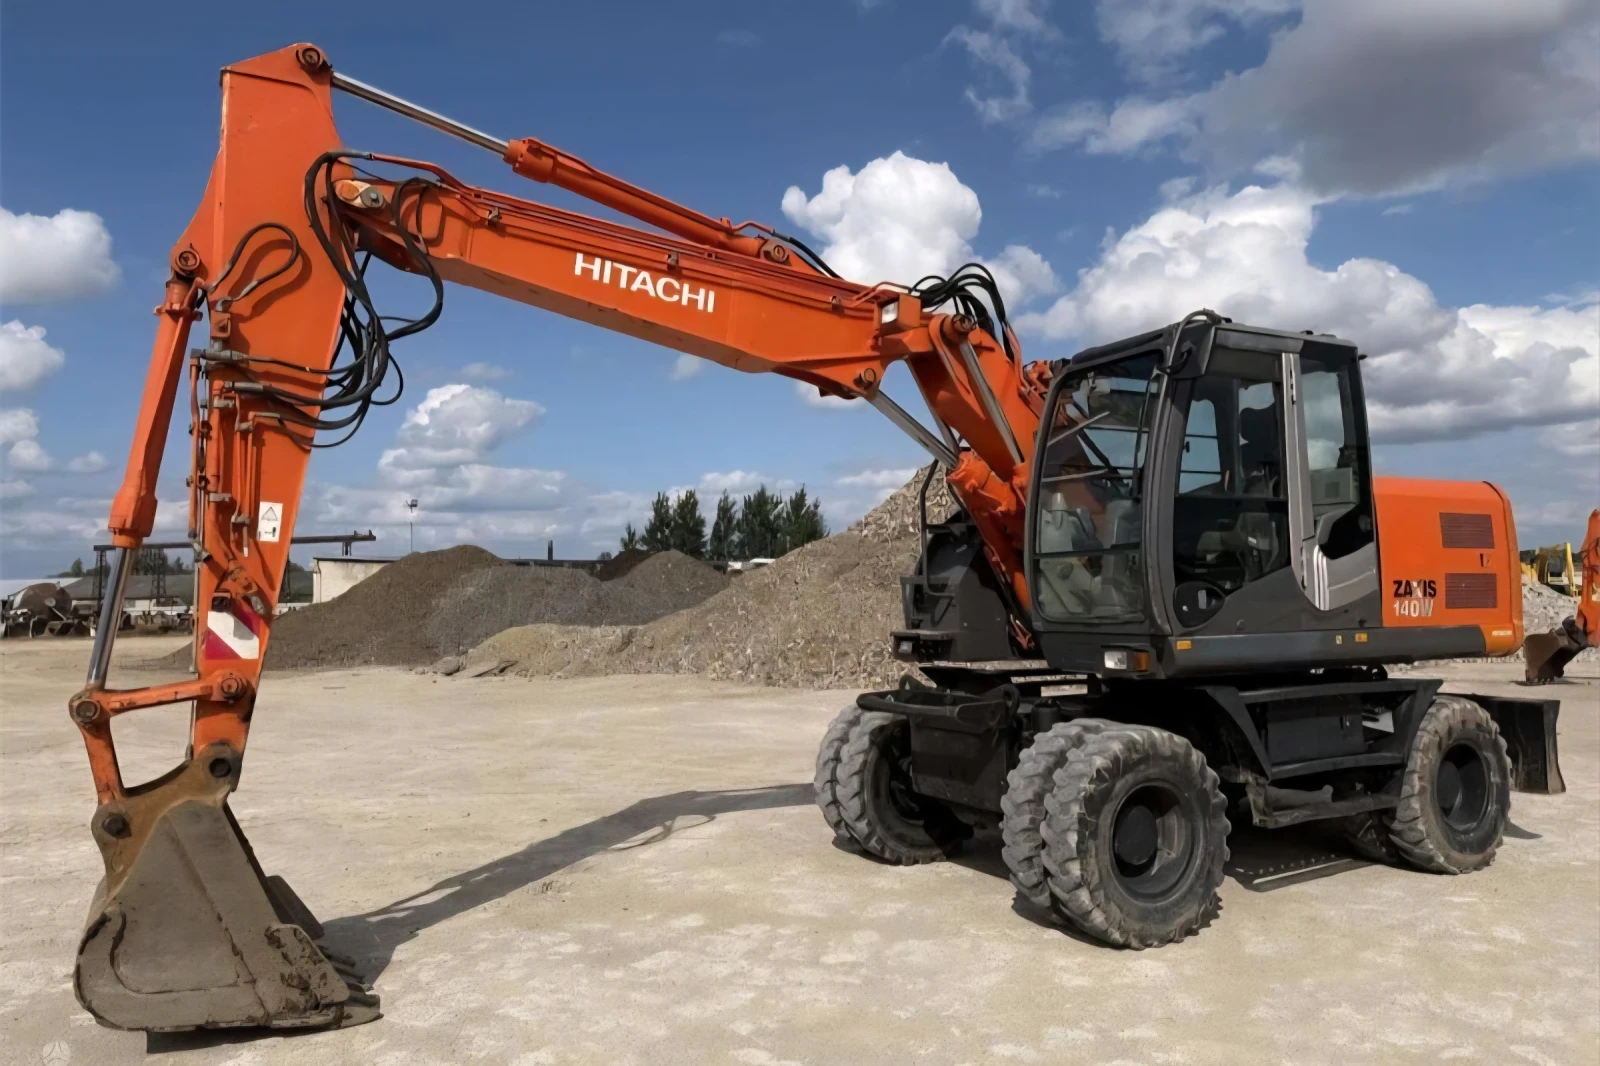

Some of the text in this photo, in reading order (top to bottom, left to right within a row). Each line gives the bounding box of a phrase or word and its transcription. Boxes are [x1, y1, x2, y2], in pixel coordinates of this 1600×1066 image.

[574, 252, 715, 313] HITACHI
[1393, 579, 1437, 598] ZAXIS
[1394, 599, 1434, 617] 140W
